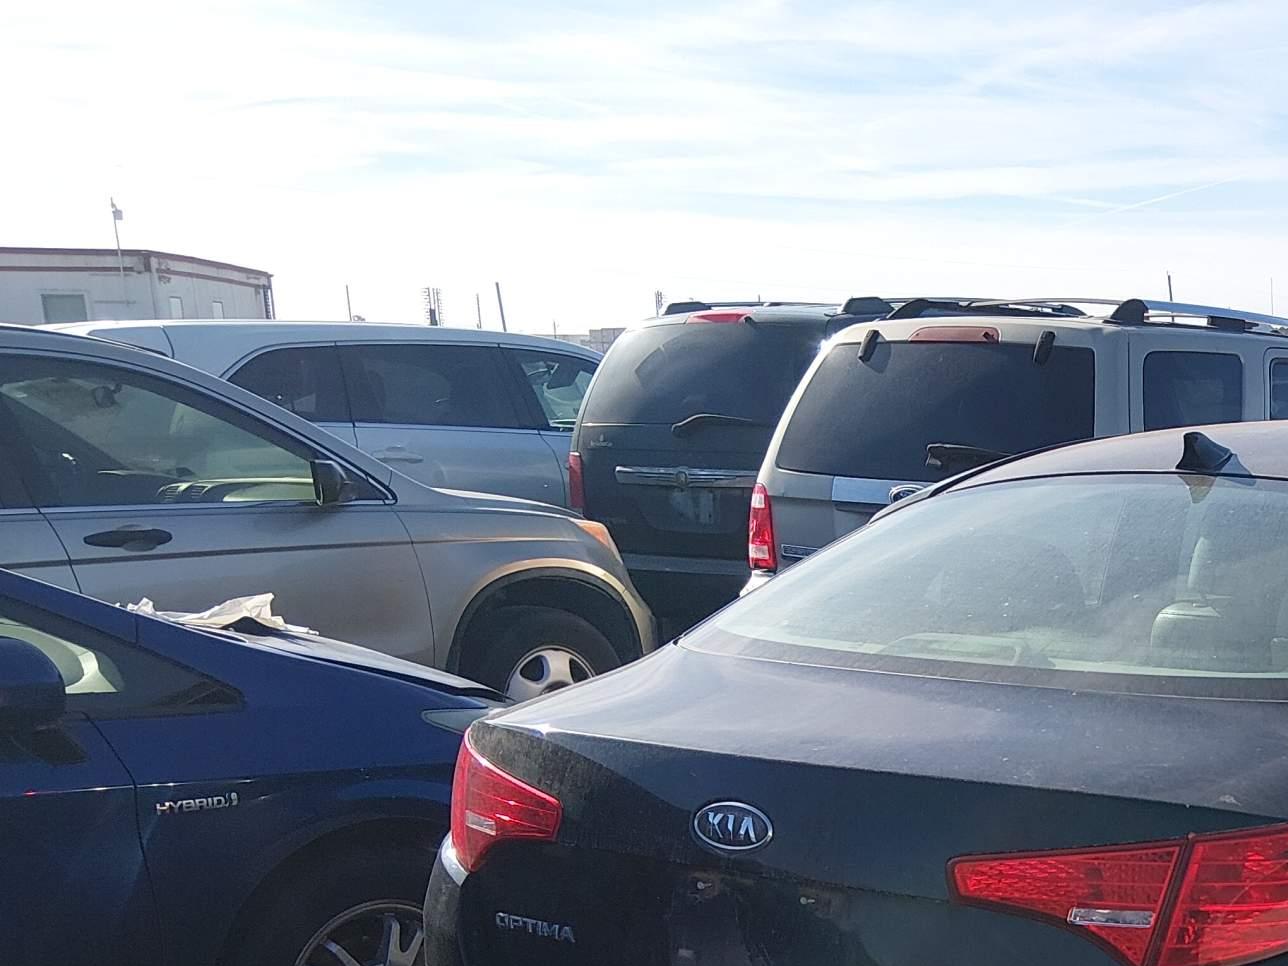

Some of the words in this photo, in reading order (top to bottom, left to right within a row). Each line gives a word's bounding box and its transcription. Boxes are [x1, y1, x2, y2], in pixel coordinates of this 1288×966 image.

[156, 796, 226, 815] HYBRID
[707, 811, 757, 843] KIA
[495, 912, 576, 943] OPTIMA
